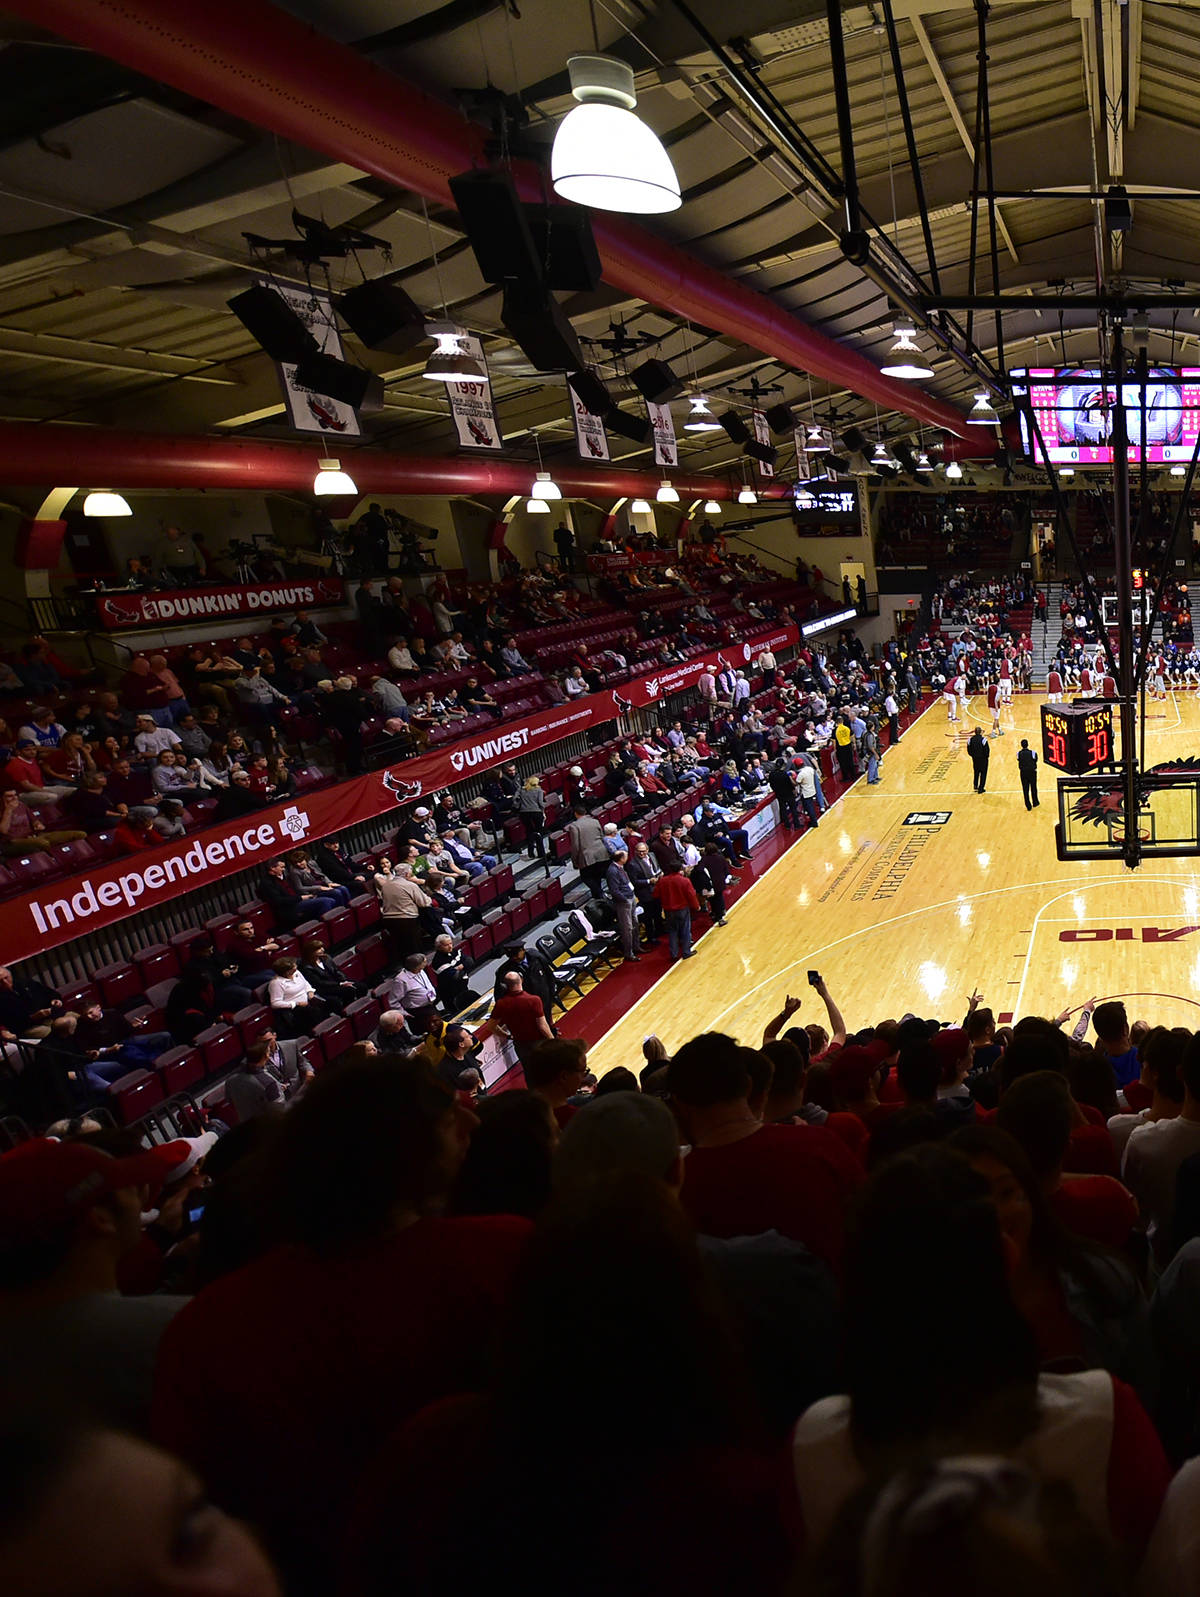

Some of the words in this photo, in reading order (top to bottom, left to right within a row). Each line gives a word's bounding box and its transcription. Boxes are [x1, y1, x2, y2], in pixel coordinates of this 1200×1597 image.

[455, 382, 484, 397] 1997
[1071, 450, 1078, 459] 0
[1164, 450, 1171, 459] 0
[1015, 472, 1063, 481] WELCOE
[158, 594, 243, 619] DUNKIN'
[247, 586, 315, 609] DONUTS
[1045, 713, 1068, 735] 10:54
[1085, 711, 1110, 733] 10:54
[464, 727, 529, 767] UNIVEST
[1048, 731, 1066, 766] 30
[1088, 730, 1108, 766] 30
[29, 823, 276, 934] Independence
[872, 826, 942, 901] PHILADELPHIA
[851, 861, 890, 902] COMPANIES
